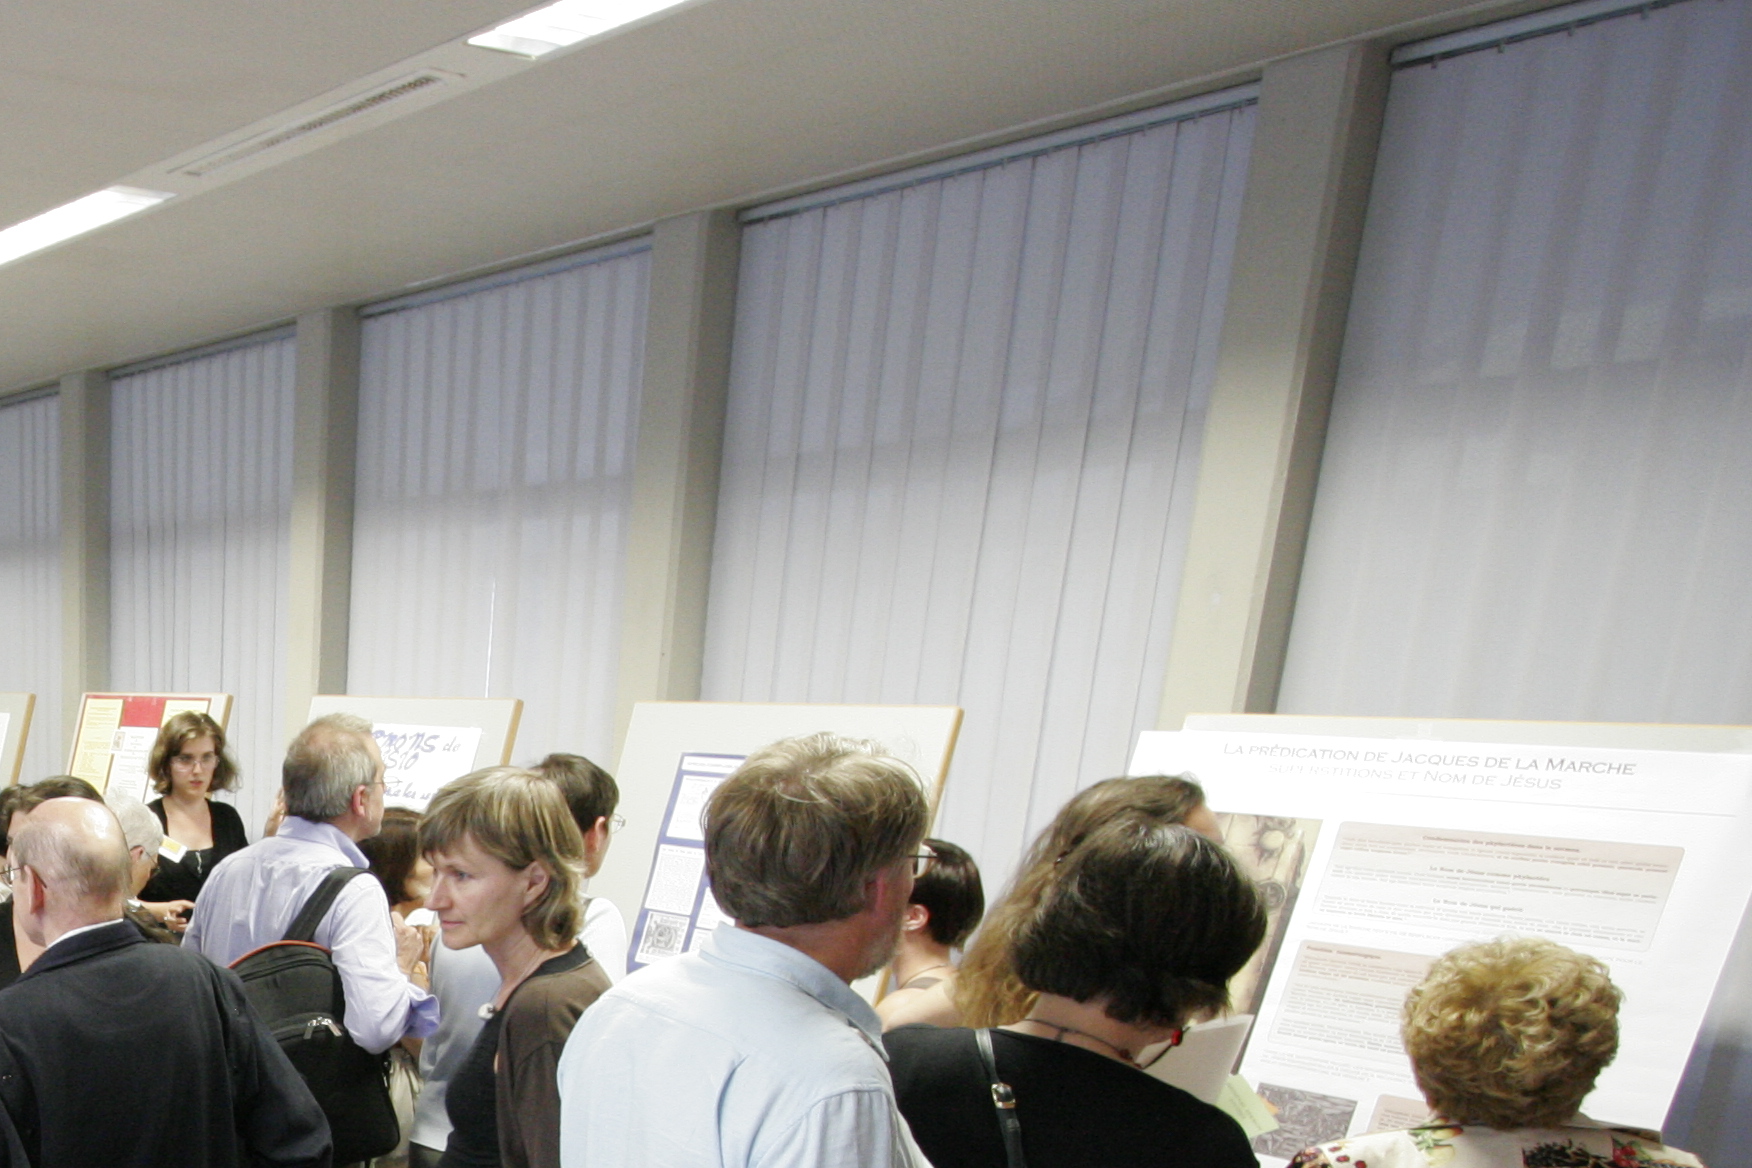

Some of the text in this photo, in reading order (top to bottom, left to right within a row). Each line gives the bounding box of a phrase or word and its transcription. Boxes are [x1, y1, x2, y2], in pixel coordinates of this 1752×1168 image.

[1223, 743, 1637, 776] LA PRÉDICATION DE JACQUES DE LA MARCHE
[1397, 770, 1420, 781] ET
[1423, 770, 1466, 785] NOM
[1471, 775, 1497, 787] DE
[1500, 774, 1563, 790] JÉSUS
